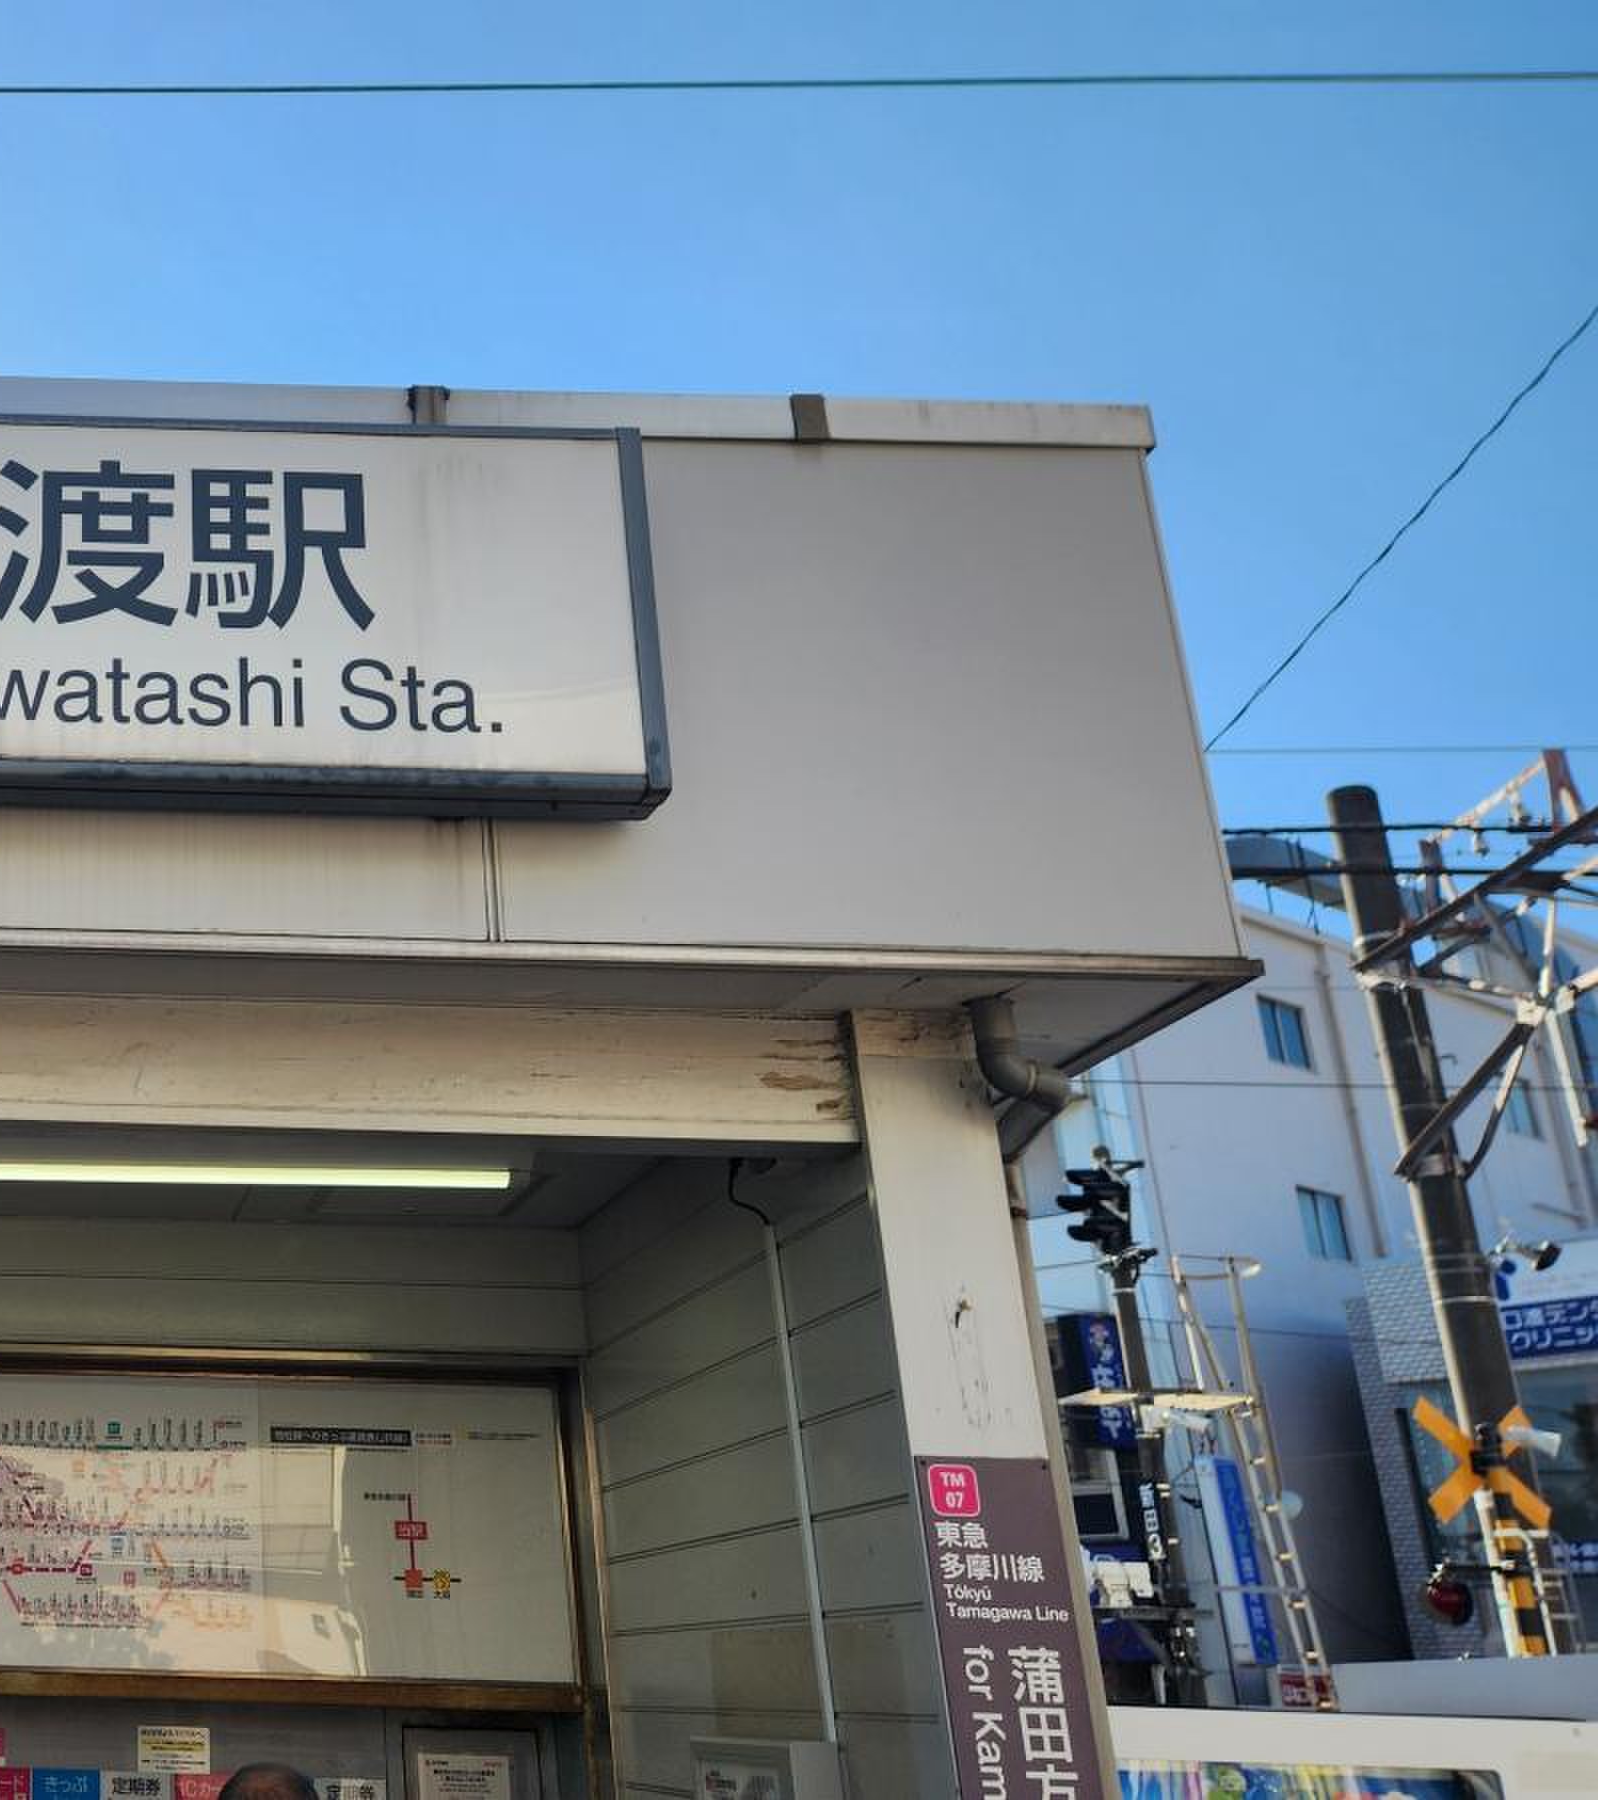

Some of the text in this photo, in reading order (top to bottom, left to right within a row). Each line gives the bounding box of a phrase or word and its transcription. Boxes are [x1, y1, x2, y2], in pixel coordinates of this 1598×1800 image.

[339, 656, 503, 733] Sta.
[1510, 1324, 1598, 1353] クリニッ
[939, 1471, 967, 1487] TM
[945, 1492, 965, 1509] 07
[934, 1521, 989, 1549] 東急
[940, 1554, 1045, 1583] 多摩川線
[945, 1602, 1069, 1623] Tamagawa Line
[963, 1645, 995, 1701] for
[43, 1775, 88, 1793] きっぷ
[111, 1776, 162, 1796] 定期券
